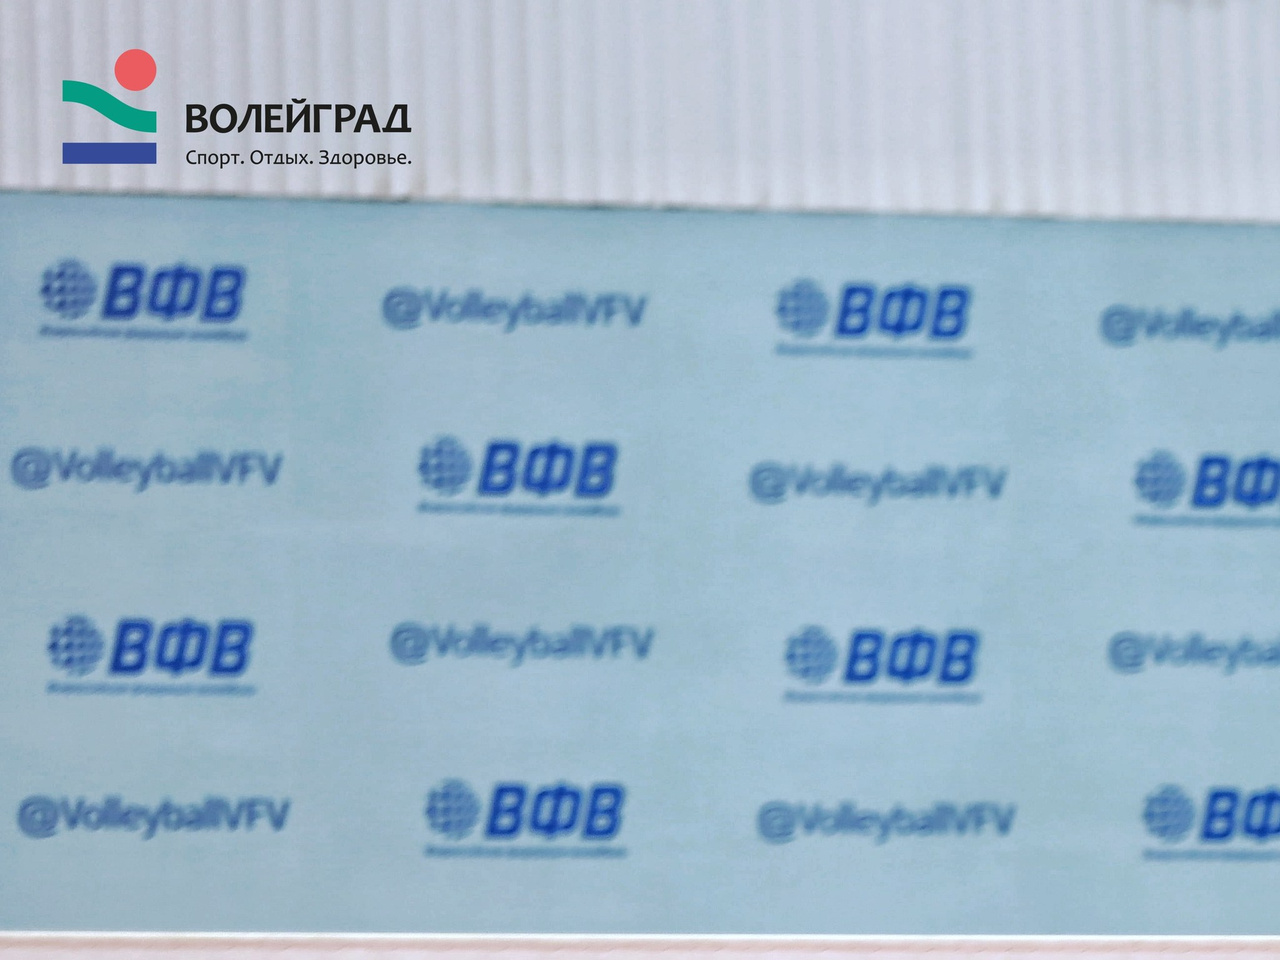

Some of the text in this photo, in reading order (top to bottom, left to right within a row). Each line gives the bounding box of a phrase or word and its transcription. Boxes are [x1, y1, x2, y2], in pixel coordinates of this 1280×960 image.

[100, 263, 247, 323] ВФВ
[834, 283, 972, 341] ВФВ
[476, 440, 619, 499] ВФВ
[108, 618, 254, 677] ВФВ
[843, 628, 981, 686] ВФВ
[484, 782, 626, 841] ВФВ
